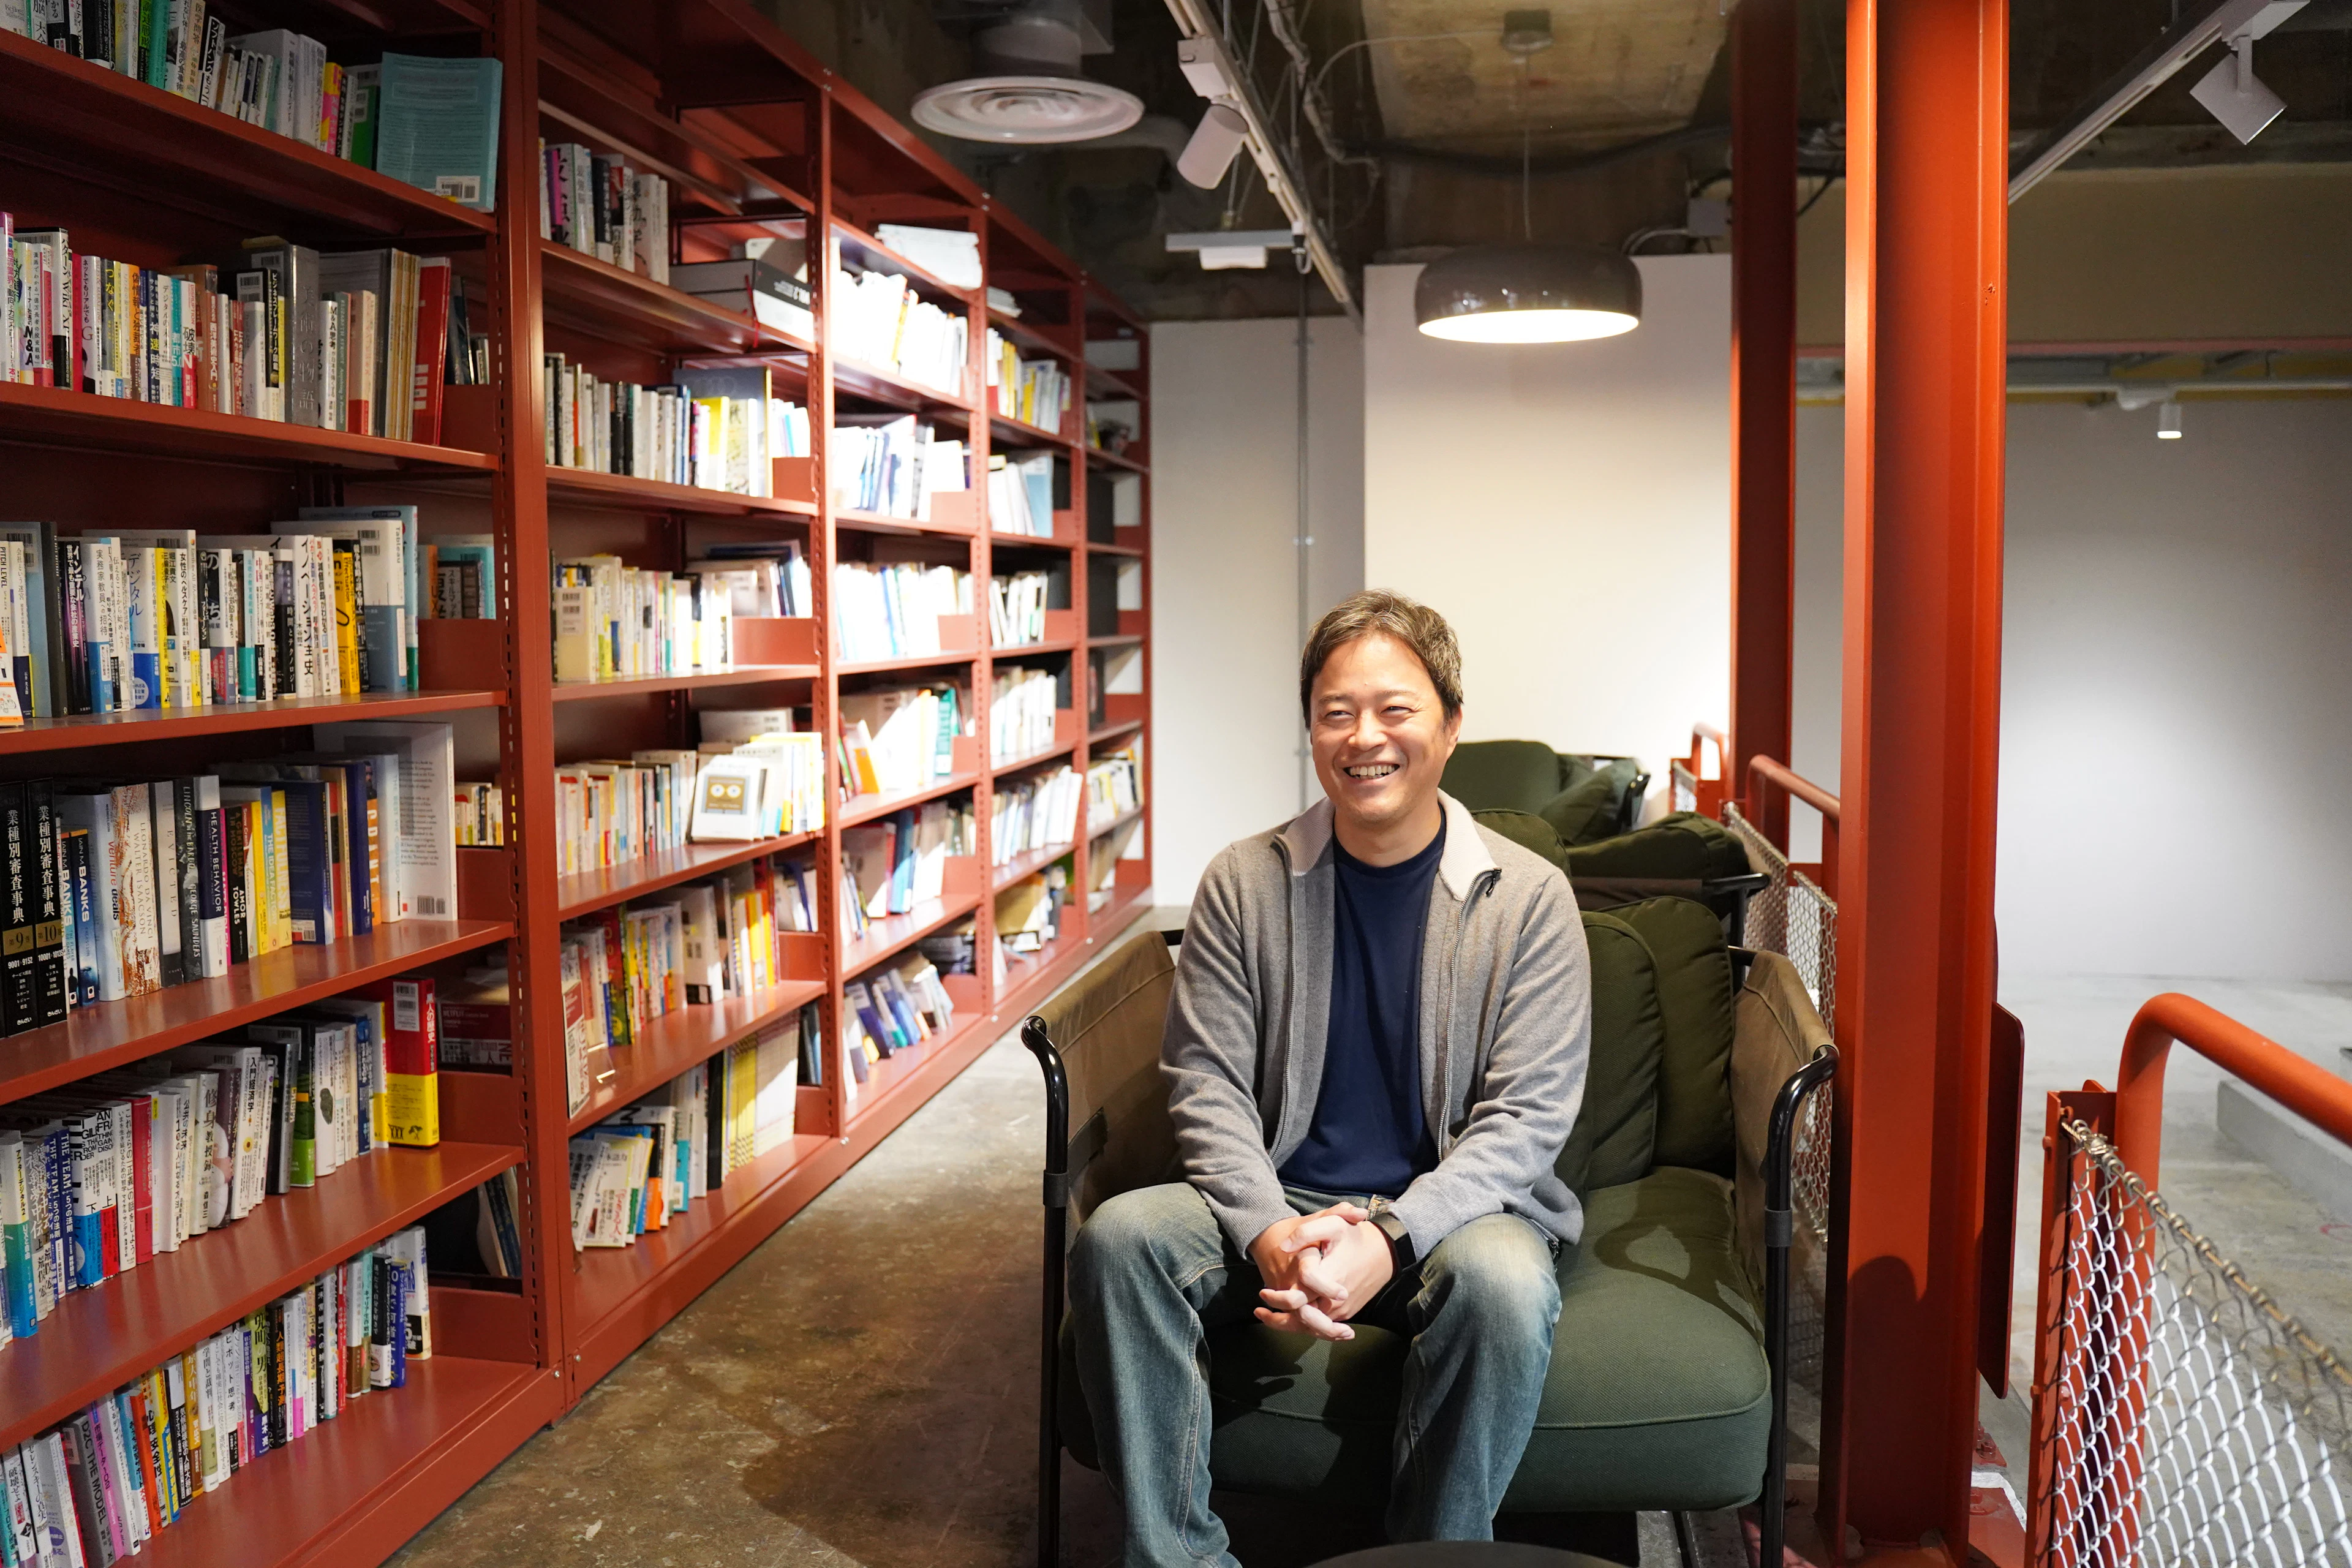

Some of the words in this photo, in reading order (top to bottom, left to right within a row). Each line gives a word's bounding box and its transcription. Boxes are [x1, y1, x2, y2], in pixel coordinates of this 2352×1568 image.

[105, 269, 115, 312] つなぐ
[183, 326, 196, 356] 破壊
[73, 545, 85, 602] インテル
[96, 549, 108, 636] 実務家教員への招待
[129, 553, 145, 617] デジタル
[301, 537, 314, 675] イノベーション全史
[183, 786, 192, 825] LINCOLN
[7, 809, 24, 924] 業種別審査事典
[37, 805, 55, 919] 業種別審査事典
[107, 841, 118, 887] venture
[134, 832, 143, 876] WALTER
[140, 822, 149, 883] LEONARDO
[145, 888, 151, 899] DA
[167, 830, 178, 918] EVICTED
[274, 807, 290, 910] FACTFULNESS
[62, 869, 73, 927] BANKS
[78, 865, 90, 922] BANKS
[111, 889, 119, 921] deals
[136, 878, 146, 935] ISAACSON
[213, 858, 222, 913] BEHAVIOR
[270, 882, 278, 925] FACTORY
[191, 918, 200, 959] SAUNDERS
[97, 1109, 111, 1121] AN
[48, 1138, 58, 1159] THE
[61, 1133, 70, 1157] THE
[50, 1163, 59, 1194] TEAM
[62, 1159, 72, 1188] TEAM
[126, 1109, 136, 1255] これからの「正義」の話をしよう
[86, 1202, 97, 1214] 下
[102, 1195, 113, 1208] 上
[225, 1335, 236, 1411] ピボット思考
[81, 1421, 90, 1449] D2C
[87, 1452, 98, 1479] THE
[92, 1480, 107, 1525] MODEL
